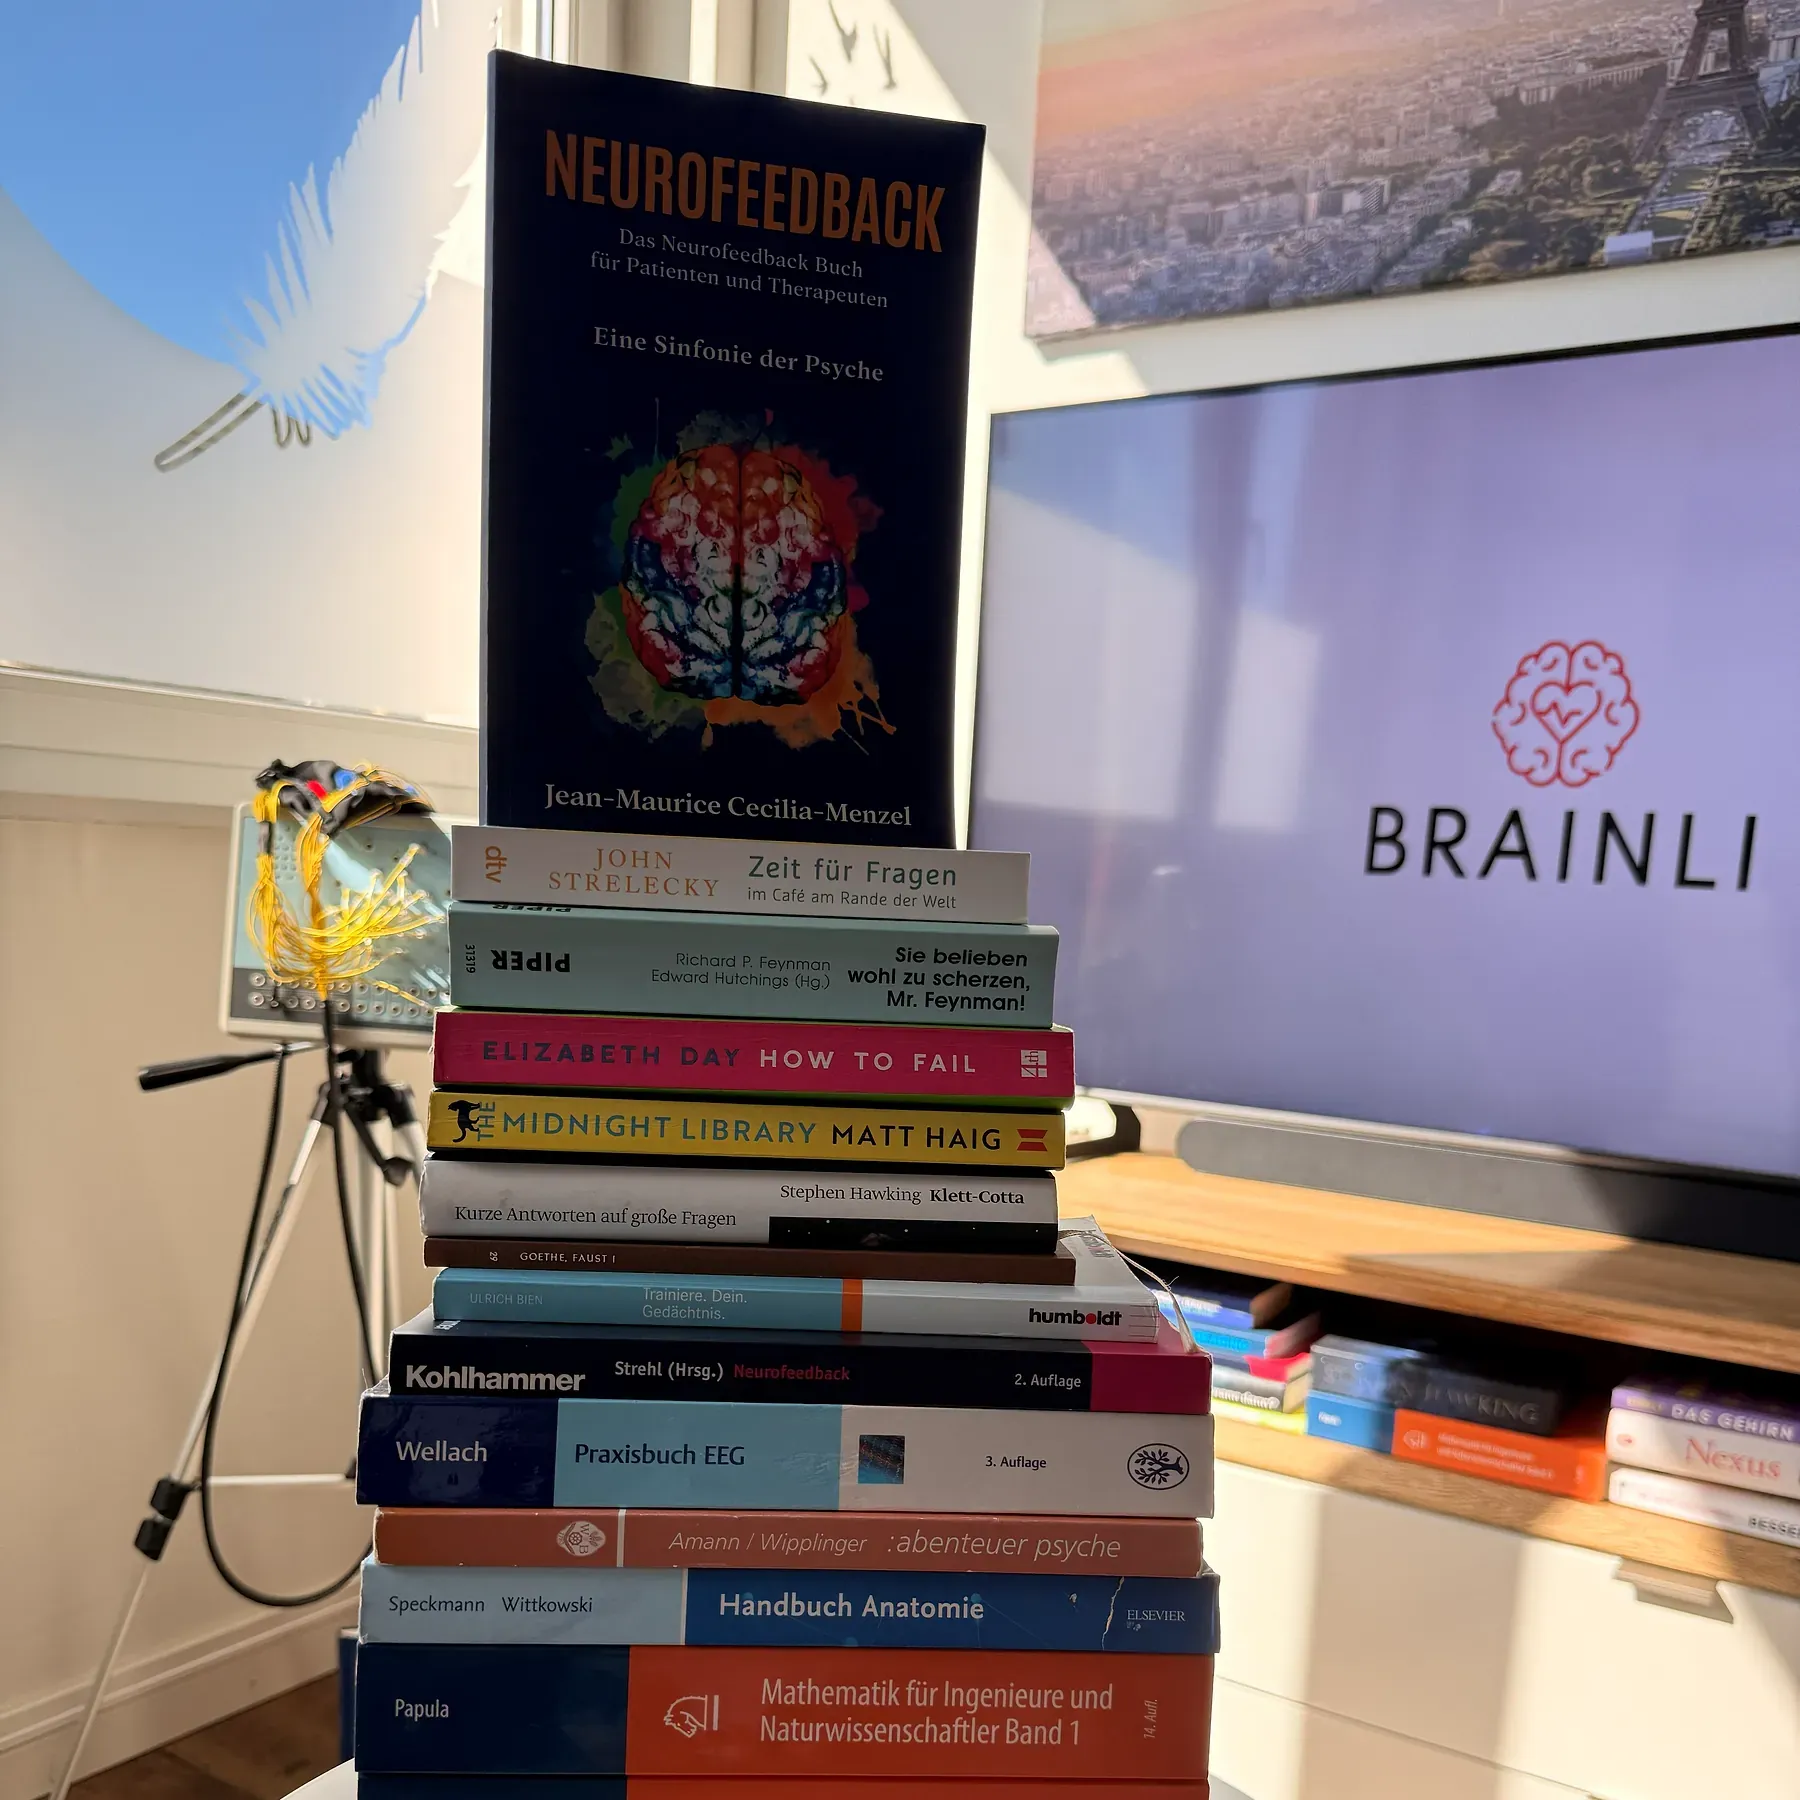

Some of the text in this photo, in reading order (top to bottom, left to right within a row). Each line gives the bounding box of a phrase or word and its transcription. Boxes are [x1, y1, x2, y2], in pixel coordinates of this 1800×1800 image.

[545, 129, 945, 252] NEUROFEEDBACK
[619, 228, 863, 278] Das Neurofeedback Buch
[591, 251, 888, 308] für Patienten und Therapeuten
[594, 326, 884, 382] Eine Sinfonie der Psyche
[544, 783, 912, 827] Jean-Maurice Cecilia-Menzel
[594, 848, 674, 871] JOHN
[1363, 806, 1757, 892] BRAINLI
[485, 845, 507, 883] dtv
[748, 855, 957, 891] Zeit für Fragen
[548, 872, 719, 897] STRELECKY
[747, 888, 956, 909] im Café am Rande der Welt
[465, 944, 476, 974] 31319
[490, 949, 570, 973] PIPER
[676, 952, 831, 975] Richard P. Feynman
[895, 946, 1028, 967] Sie belieben
[651, 969, 830, 991] Edward Hutchings (Hg.)
[847, 967, 1031, 992] wohl zu scherzen,
[887, 990, 1026, 1013] Mr. Feynman!
[483, 1041, 976, 1074] ELIZABETH DAY HOW TO FAIL
[477, 1101, 496, 1142] THE
[503, 1111, 817, 1145] MIDNIGHT LIBRARY
[832, 1124, 1002, 1152] MATT HAIG
[780, 1183, 1025, 1206] Stephen Hawking Klett-Cotta
[454, 1206, 737, 1229] Kurze Antworten auf große Fragen
[572, 1253, 608, 1263] FAUST
[470, 1293, 543, 1305] ULRICH BIEN
[642, 1288, 748, 1304] Trainiere. Dein.
[642, 1304, 726, 1320] Gedächtnis.
[1029, 1308, 1122, 1326] humboldt
[406, 1364, 585, 1391] Kohlhammer
[614, 1360, 850, 1382] Strehl (Hrsg.) Neurofeedback
[1014, 1372, 1082, 1390] 2. Auflage
[1671, 1403, 1713, 1424] DAS
[1717, 1412, 1795, 1441] GEHIRN
[396, 1440, 488, 1462] Wellach
[574, 1443, 745, 1466] Praxisbuch EEG
[1685, 1436, 1782, 1479] Nexus
[985, 1456, 1047, 1471] 3. Auflage
[1748, 1515, 1800, 1539] BESSE
[668, 1532, 740, 1550] Amann
[760, 1533, 867, 1555] Wipplinger
[888, 1529, 1121, 1562] :abenteuer psyche
[388, 1595, 593, 1616] Speckmann Wittkowski
[720, 1592, 984, 1619] Handbuch Anatomie
[1126, 1609, 1186, 1622] ELSEVIER
[761, 1678, 1113, 1714] Mathematik für Ingenieure und
[395, 1698, 450, 1721] Papula
[1143, 1699, 1158, 1739] 14. Aufl.
[760, 1714, 1080, 1746] Naturwissenschaftler Band 1
